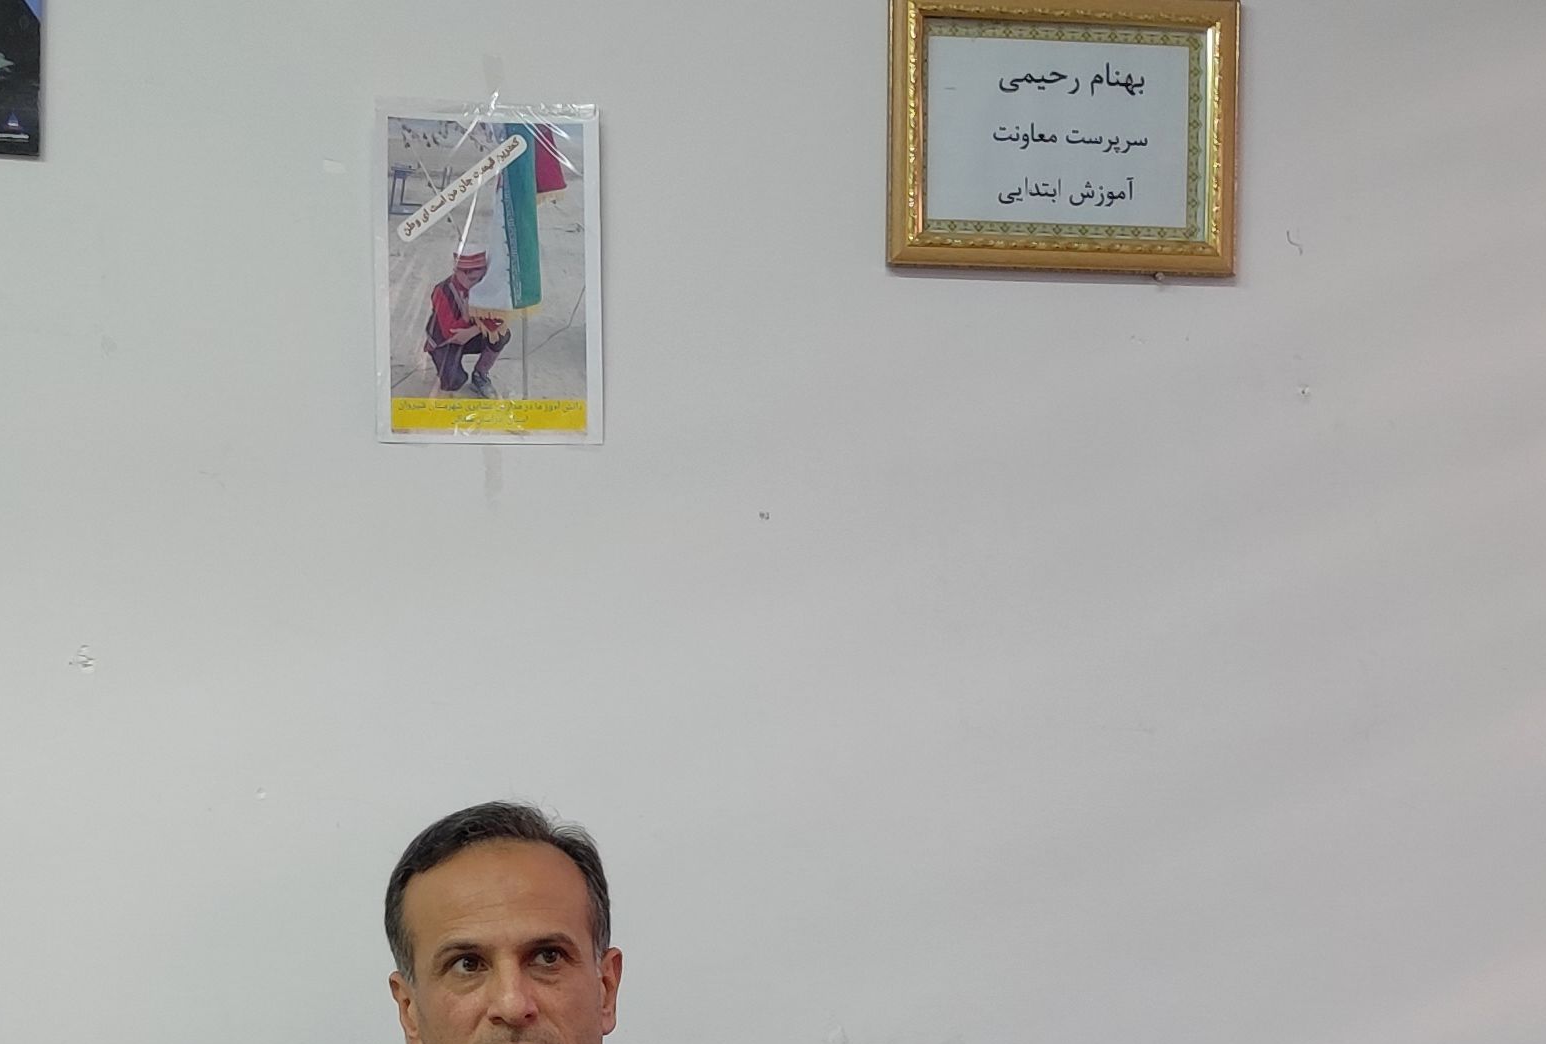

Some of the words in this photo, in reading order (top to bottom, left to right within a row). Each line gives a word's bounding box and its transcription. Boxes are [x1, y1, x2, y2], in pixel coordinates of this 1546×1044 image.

[999, 70, 1080, 95] رحیمی
[1090, 62, 1145, 96] بهنام
[993, 122, 1058, 152] معاونت
[1065, 130, 1149, 154] سرپرست
[459, 178, 473, 193] جان
[998, 177, 1062, 205] ابتدایی
[1069, 176, 1135, 207] آموزش
[430, 194, 447, 213] است
